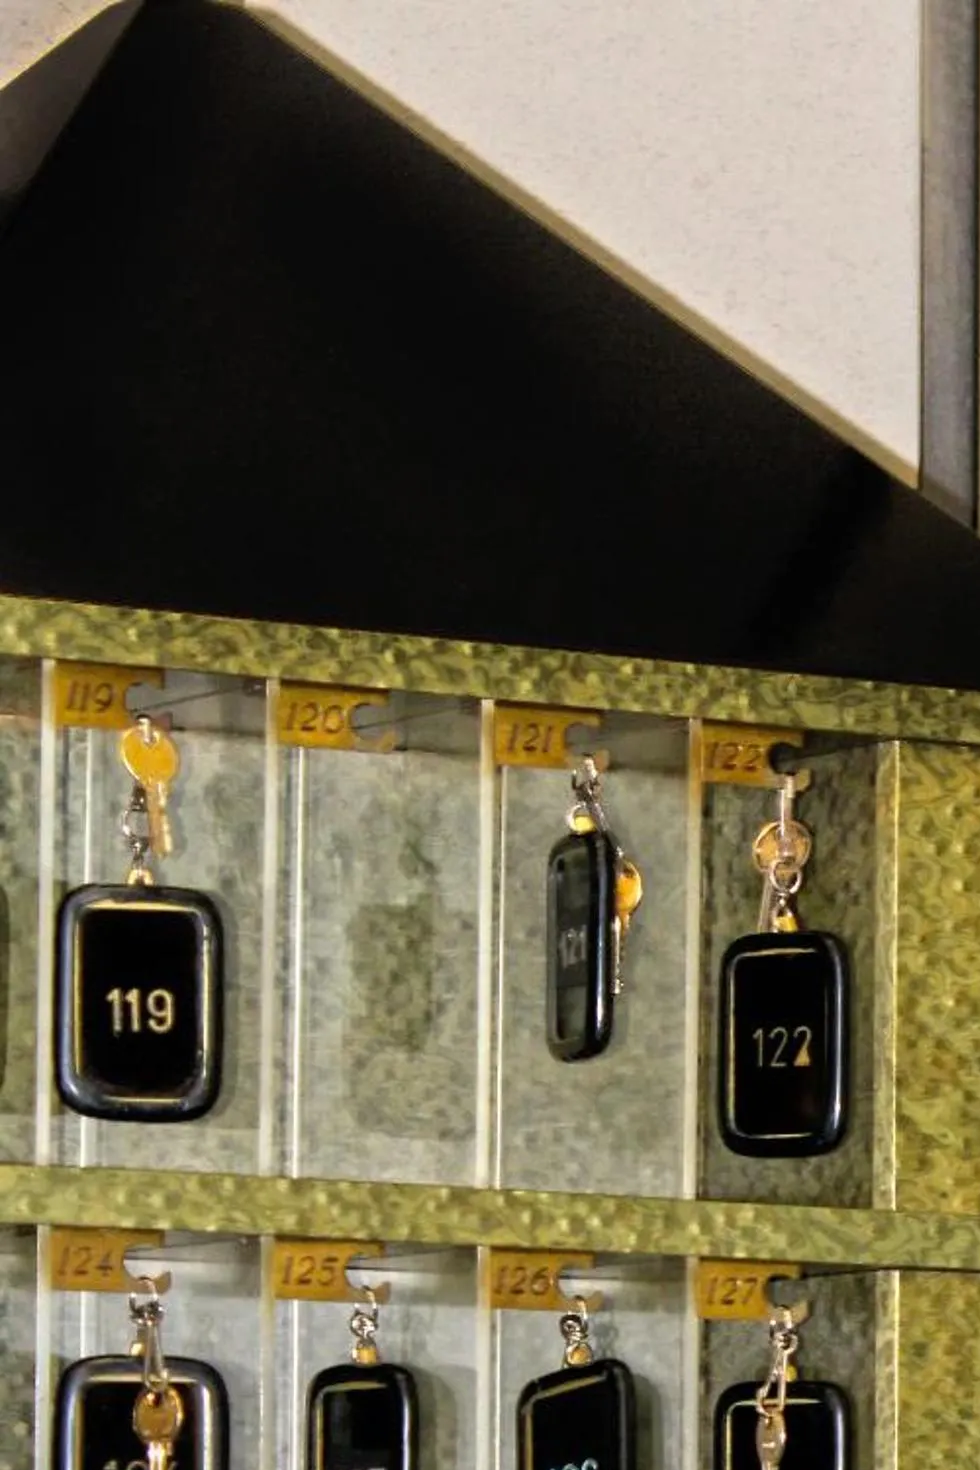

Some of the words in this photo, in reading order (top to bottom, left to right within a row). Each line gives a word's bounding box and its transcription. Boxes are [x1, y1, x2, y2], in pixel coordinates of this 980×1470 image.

[67, 681, 114, 713] 119
[285, 699, 342, 733] 120
[508, 723, 554, 753] 121
[705, 741, 764, 772] 122
[105, 988, 174, 1034] 119
[752, 1026, 812, 1067] 122
[55, 1246, 116, 1277] 124
[281, 1254, 338, 1286] 125
[494, 1266, 551, 1296] 126
[705, 1276, 758, 1305] 127
